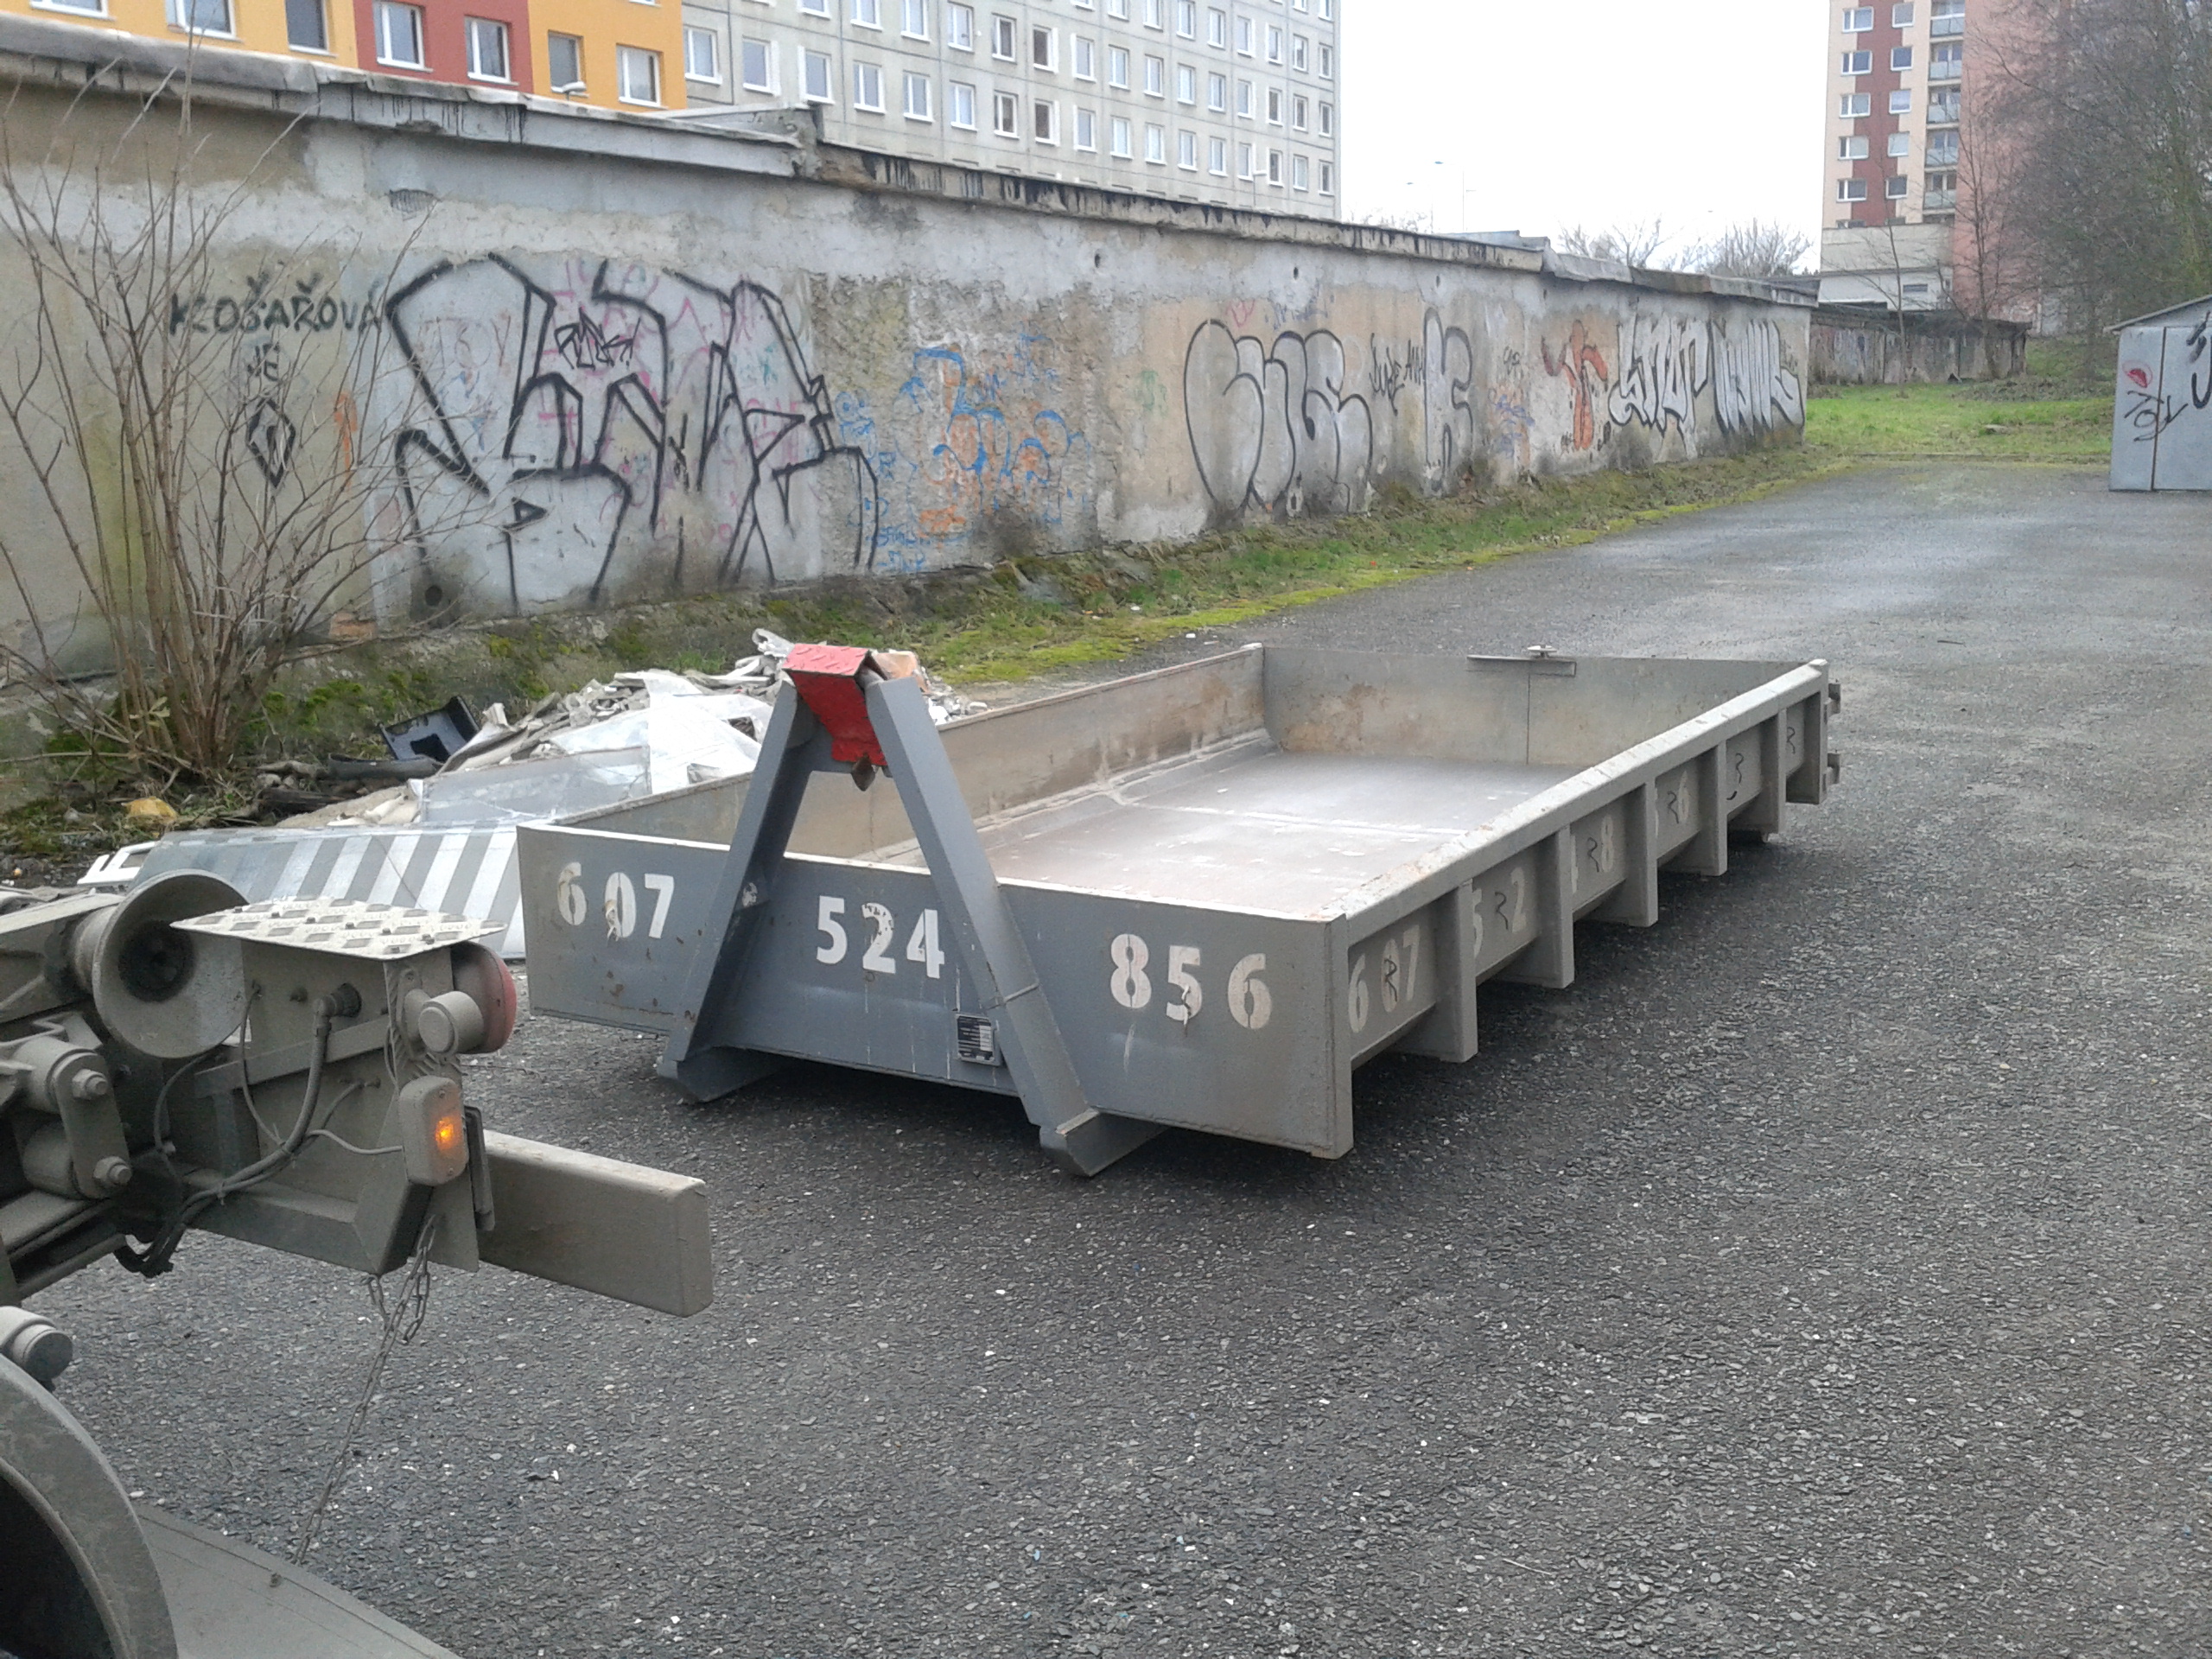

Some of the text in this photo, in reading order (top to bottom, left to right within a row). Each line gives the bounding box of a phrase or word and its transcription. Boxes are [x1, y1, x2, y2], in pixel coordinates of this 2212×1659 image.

[557, 861, 1272, 1030] 607 524 856
[1348, 924, 1421, 1033] 607
